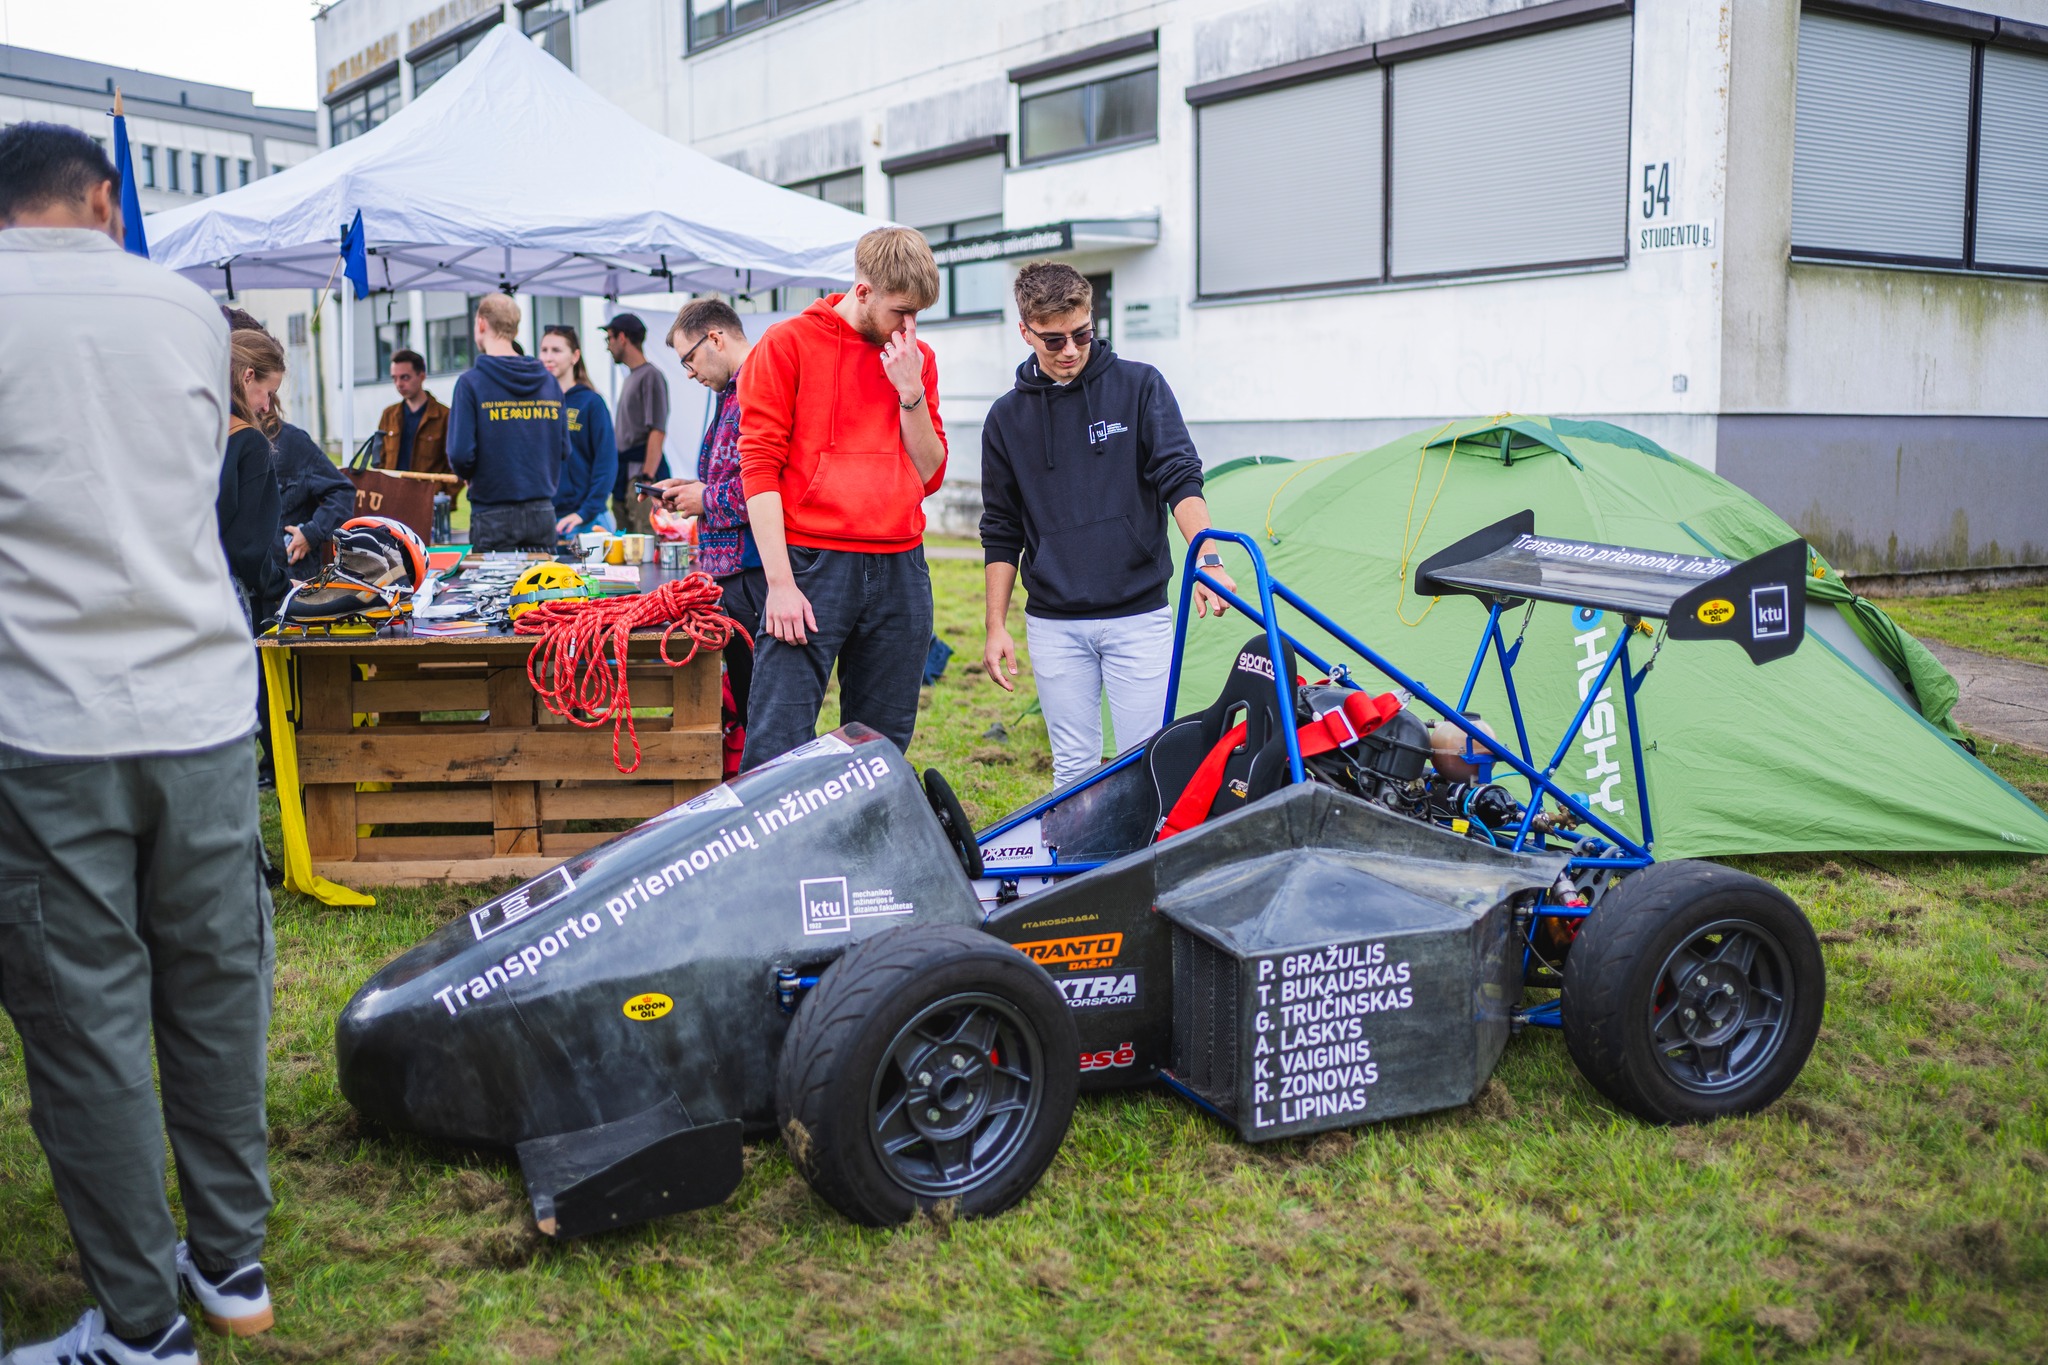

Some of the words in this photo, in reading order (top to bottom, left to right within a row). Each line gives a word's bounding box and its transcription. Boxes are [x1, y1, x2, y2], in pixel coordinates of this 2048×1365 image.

[1643, 162, 1670, 218] 54
[1641, 224, 1700, 249] STUDENTŲ
[1702, 227, 1712, 246] g.
[356, 489, 383, 511] TU
[1513, 534, 1591, 559] Transporto
[1589, 548, 1683, 573] priemonių
[1682, 556, 1731, 575] inžin
[1703, 607, 1729, 616] KROON
[1758, 607, 1782, 622] ktu
[1574, 626, 1624, 814] HUSKY
[997, 846, 1034, 857] XTRA
[433, 910, 602, 1016] Transporto
[605, 822, 760, 926] priemonių
[753, 754, 891, 836] inžinerija
[852, 889, 893, 898] mechanikos
[810, 900, 841, 917] ktu
[853, 905, 878, 914] dizaino
[878, 902, 914, 912] fakultetas
[1021, 914, 1099, 929] #TAIKOSDRAGAI
[1068, 958, 1113, 971] DAŽAI
[1259, 960, 1276, 982] P.
[1282, 943, 1385, 977] GRAŽULIS
[1257, 985, 1276, 1007] T.
[1281, 962, 1411, 1003] BUKAUSKAS
[631, 1002, 666, 1012] KROON
[1256, 1011, 1276, 1033] G.
[1280, 987, 1414, 1027] TRUČINSKAS
[1254, 1035, 1275, 1057] A.
[1280, 1017, 1363, 1051] LASKYS
[1079, 1042, 1136, 1072] esė
[1254, 1058, 1275, 1081] K.
[1280, 1040, 1370, 1075] VAIGINIS
[1254, 1082, 1275, 1104] R.
[1280, 1063, 1379, 1099] ZONOVAS
[1256, 1107, 1276, 1128] L.
[1281, 1088, 1367, 1123] LIPINAS
